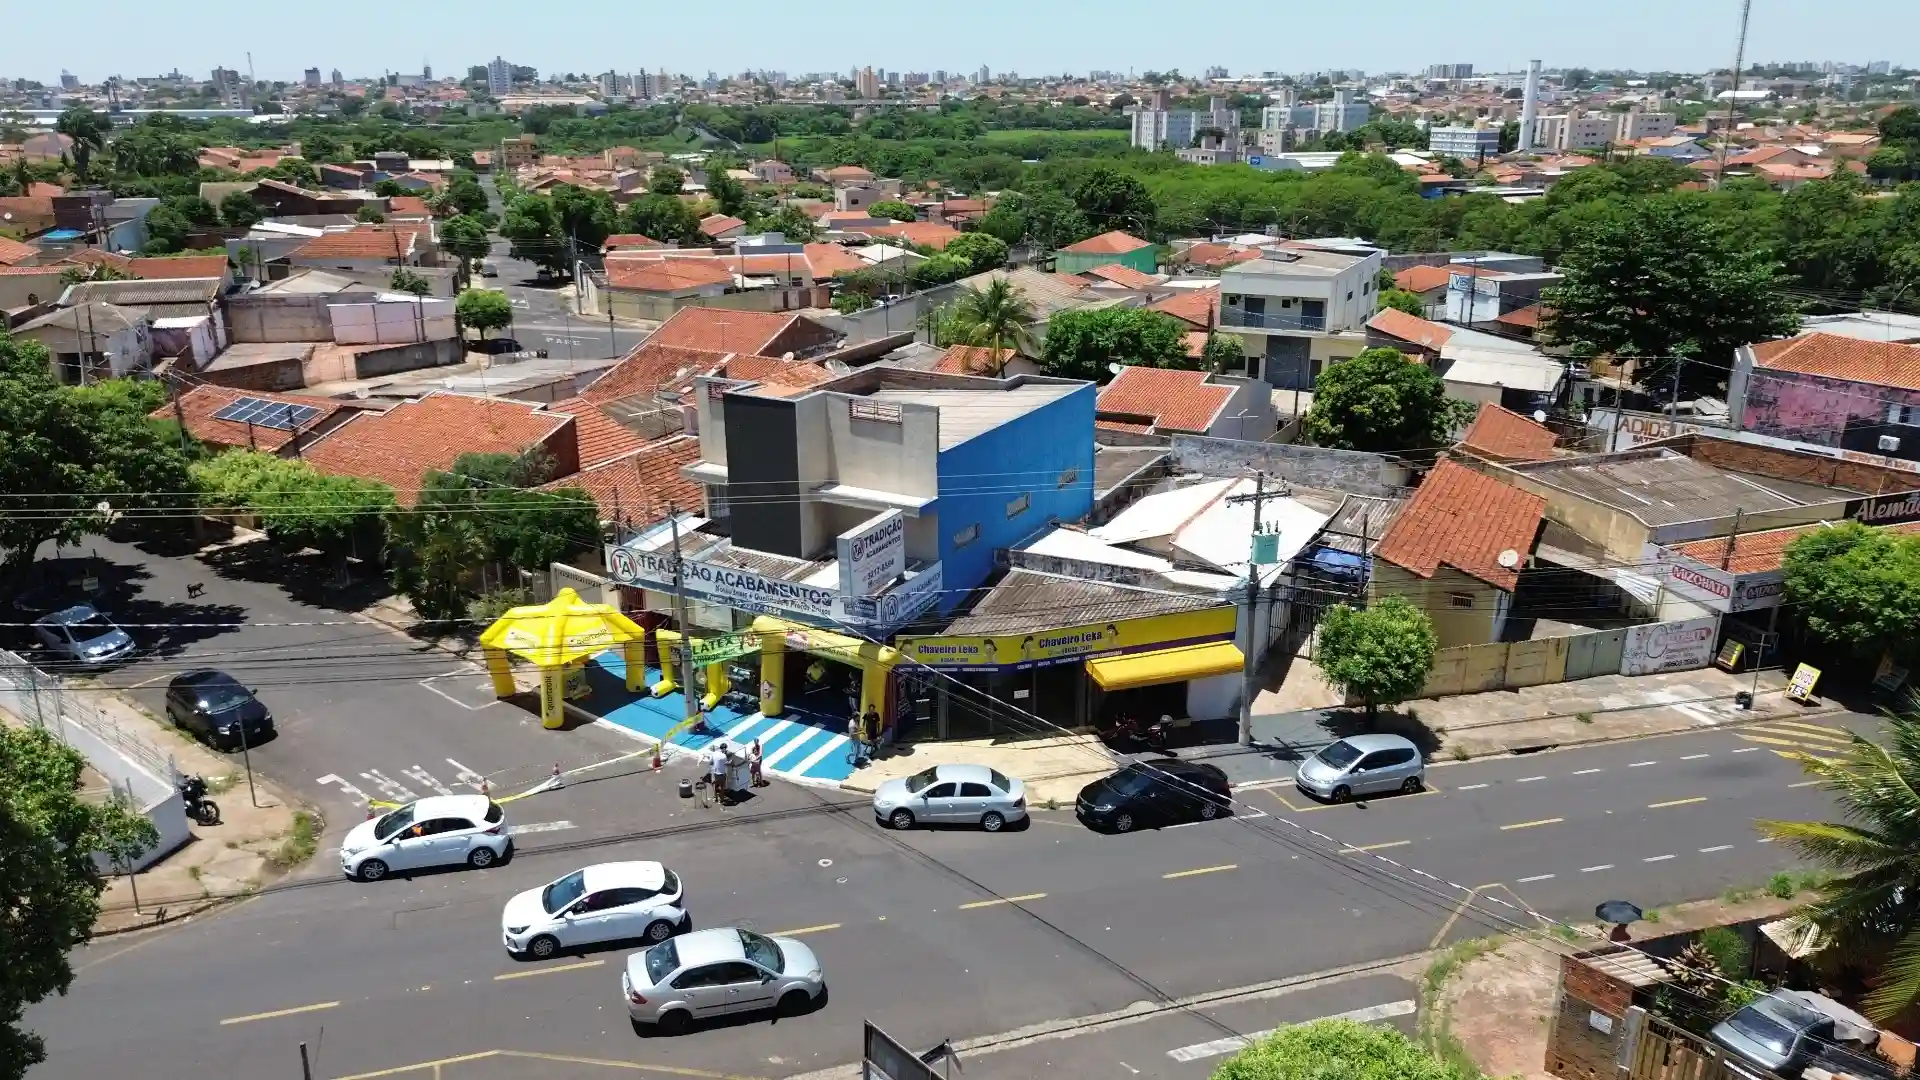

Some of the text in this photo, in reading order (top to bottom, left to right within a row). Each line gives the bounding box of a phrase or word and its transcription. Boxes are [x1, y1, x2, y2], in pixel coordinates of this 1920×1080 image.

[864, 517, 903, 549] TRADIÇÃO
[638, 554, 711, 581] TRADÇÃO
[714, 569, 833, 607] ACABAMENTOS
[692, 634, 733, 655] LATEX
[918, 644, 979, 654] Chaveiro Leka
[1039, 631, 1103, 648] Chaveiro Leka
